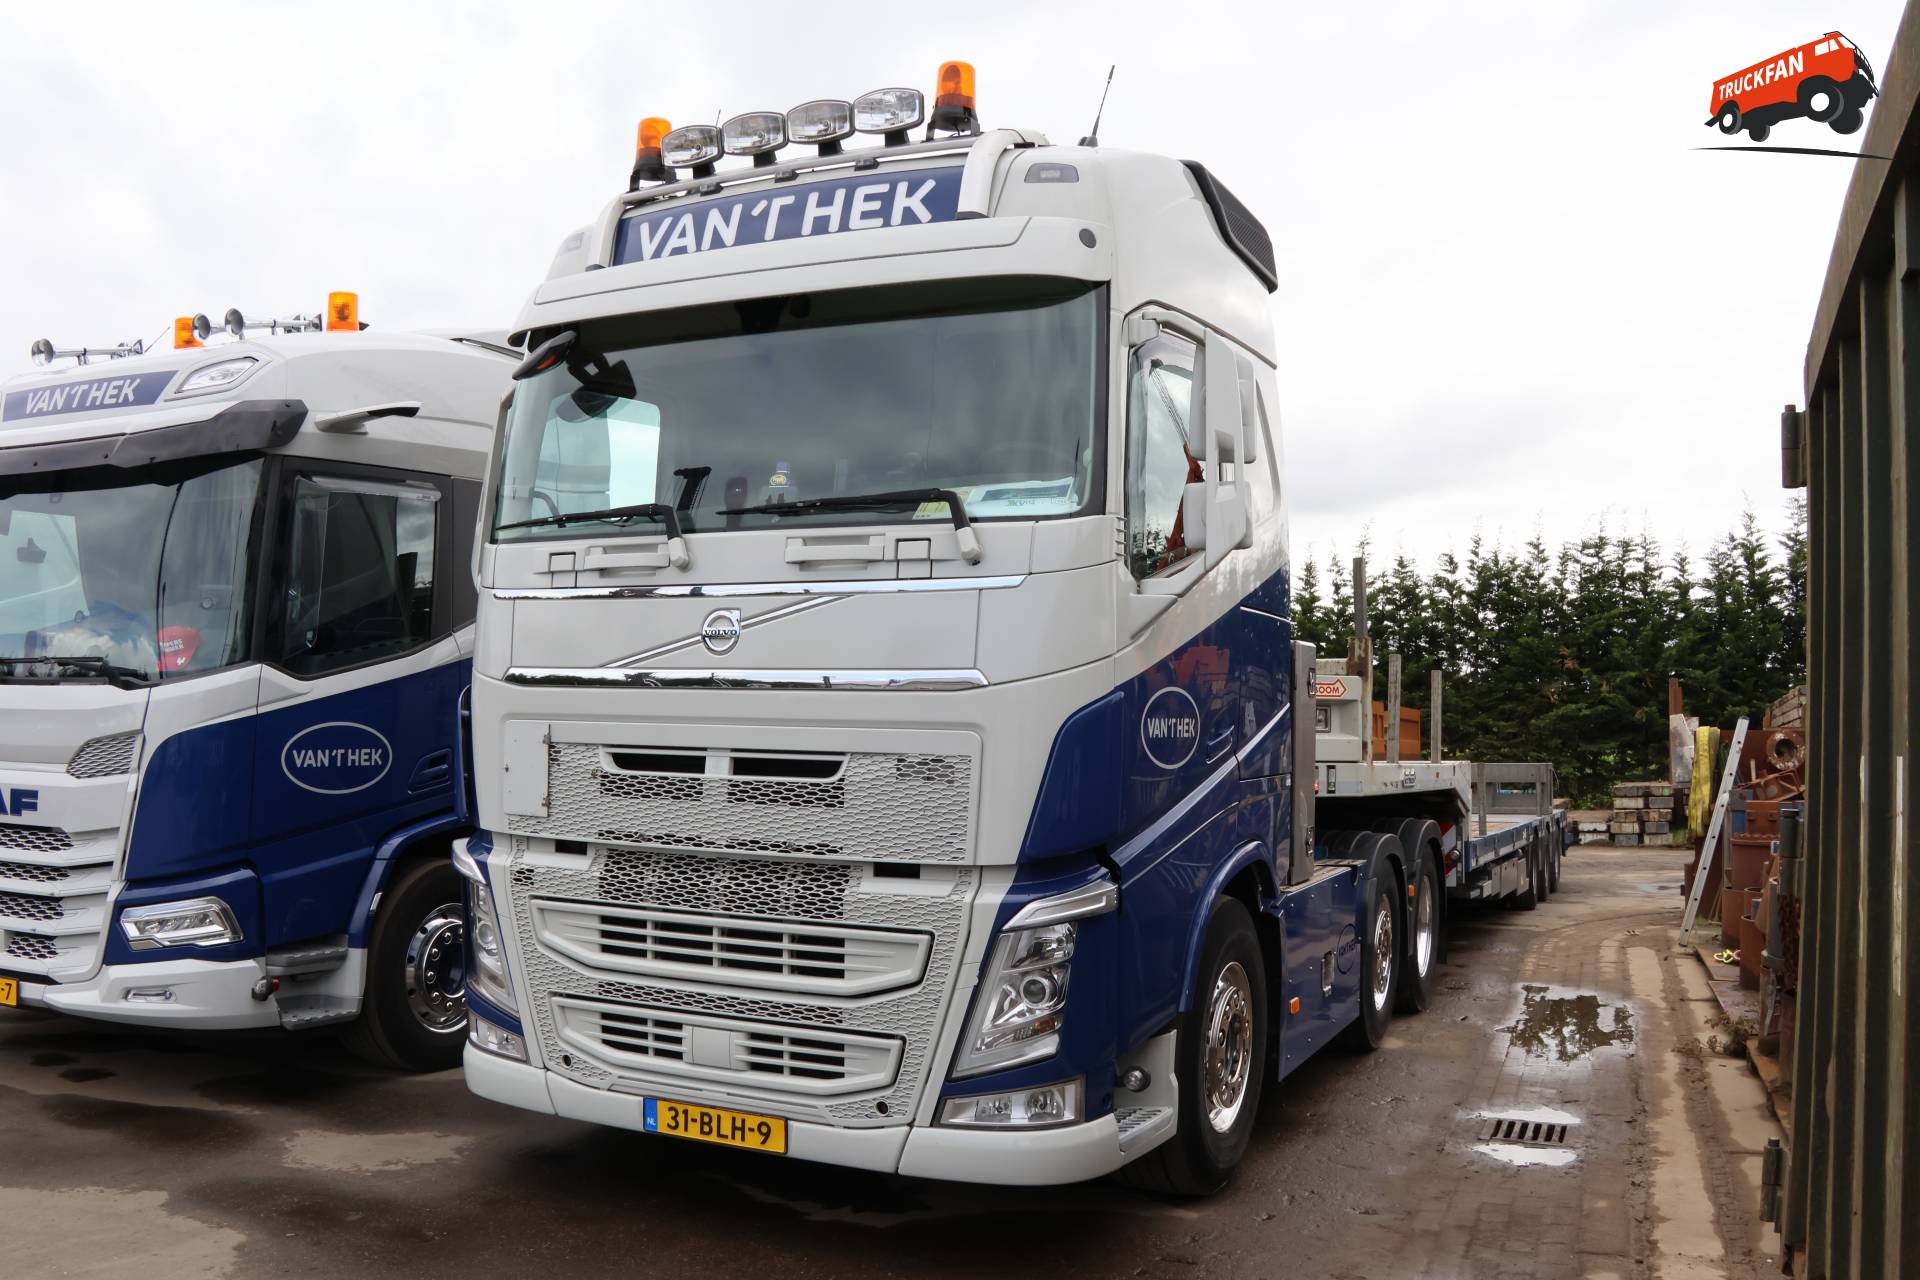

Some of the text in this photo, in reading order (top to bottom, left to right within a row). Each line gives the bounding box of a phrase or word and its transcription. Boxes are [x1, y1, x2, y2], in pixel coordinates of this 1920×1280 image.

[800, 178, 937, 237] HEK
[85, 378, 141, 407] HEK
[1176, 717, 1196, 739] HEK
[347, 748, 382, 767] HEK
[647, 1116, 657, 1127] NL
[666, 1105, 772, 1145] 31-BLH-9
